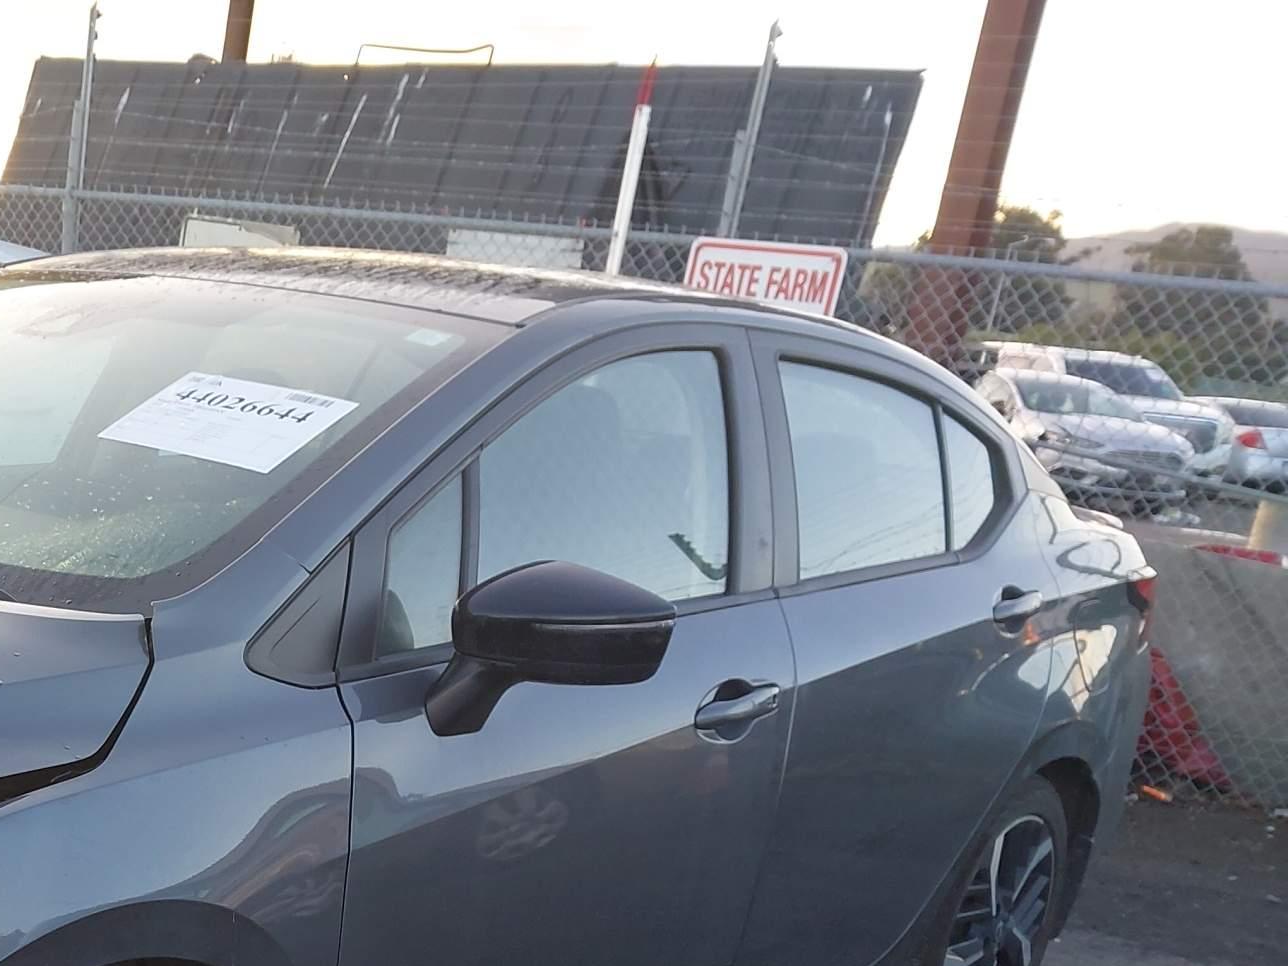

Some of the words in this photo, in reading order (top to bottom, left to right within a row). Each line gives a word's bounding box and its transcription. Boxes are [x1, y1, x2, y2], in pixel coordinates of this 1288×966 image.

[697, 260, 762, 298] STATE
[764, 265, 830, 304] FARM
[176, 388, 314, 423] 44026644
